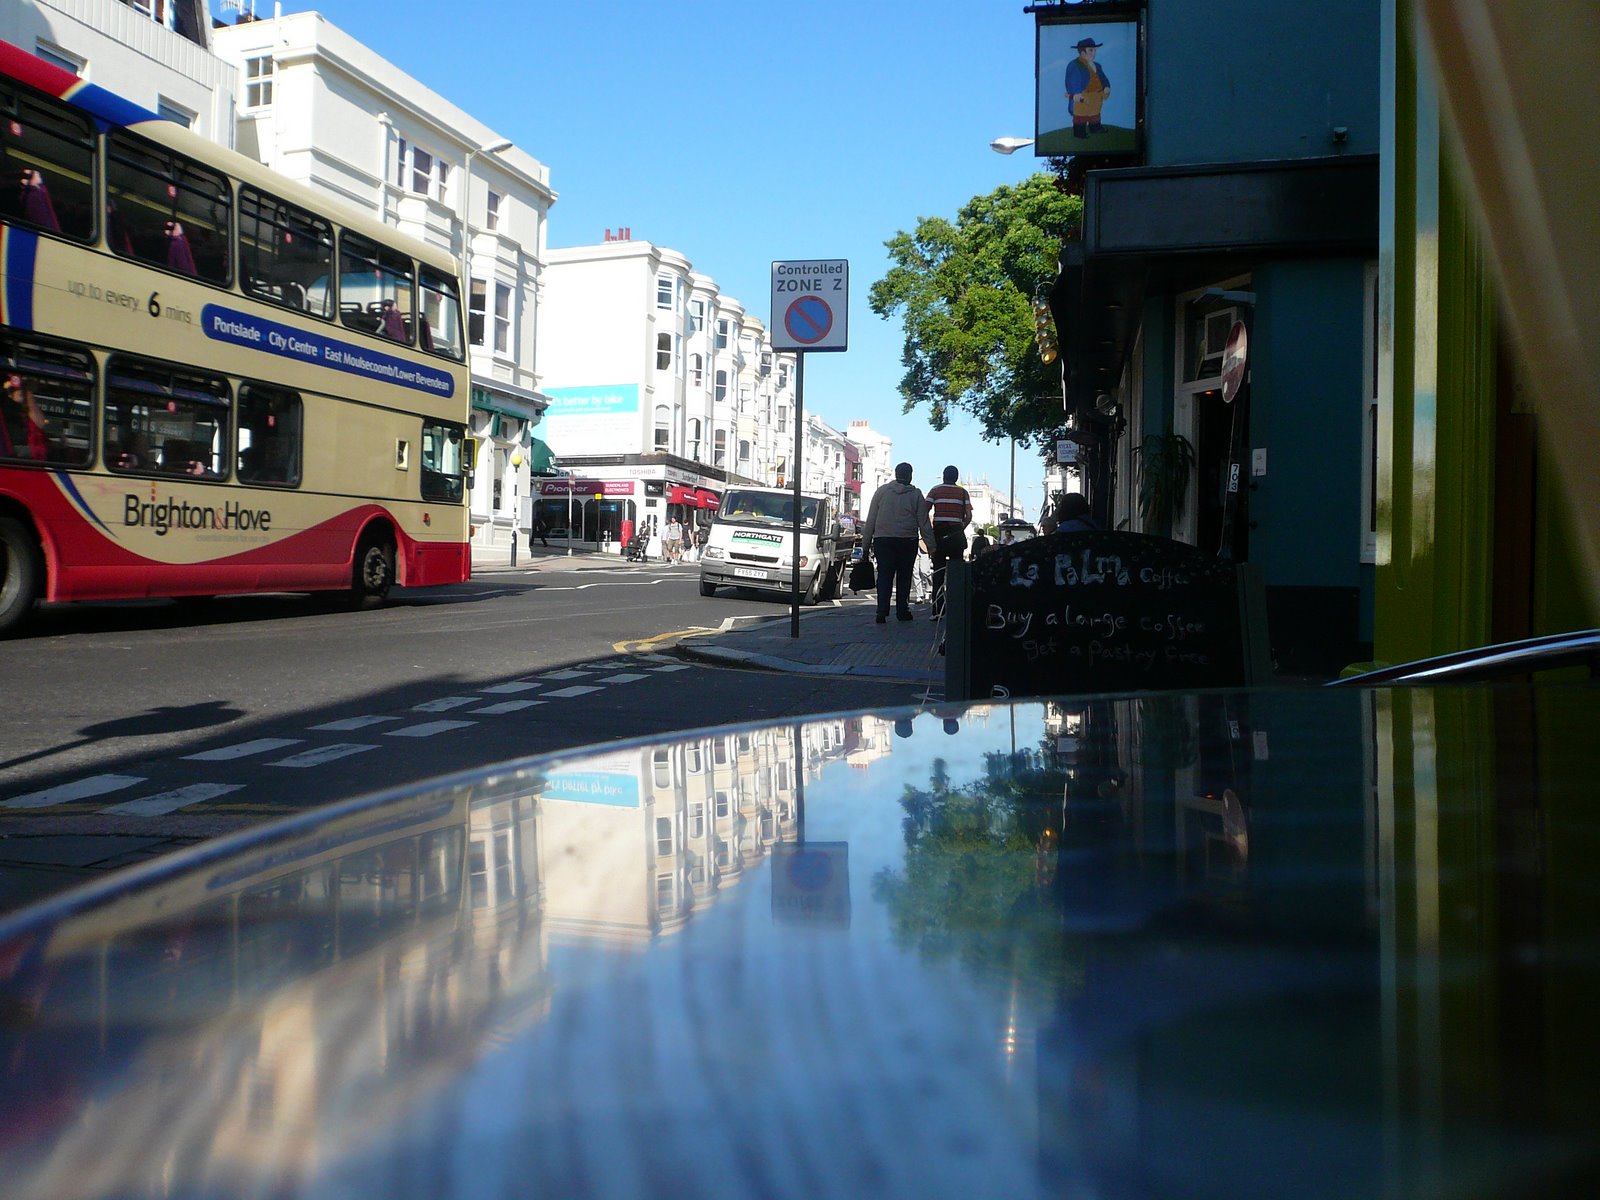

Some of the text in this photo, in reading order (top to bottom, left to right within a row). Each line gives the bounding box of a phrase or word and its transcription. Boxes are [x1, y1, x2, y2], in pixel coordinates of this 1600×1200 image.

[777, 263, 843, 275] Controlled
[776, 278, 842, 292] ZONE Z
[67, 280, 192, 325] up to every 6 mins
[213, 316, 261, 341] Portslade
[268, 331, 287, 351] City
[288, 336, 318, 356] Centre
[324, 346, 342, 363] East
[415, 372, 450, 391] Bevendean
[629, 468, 656, 476] TOSHIBA
[1231, 465, 1239, 491] 703
[734, 531, 782, 543] NORTHGATE
[986, 604, 1033, 639] Buy
[1046, 611, 1058, 625] a
